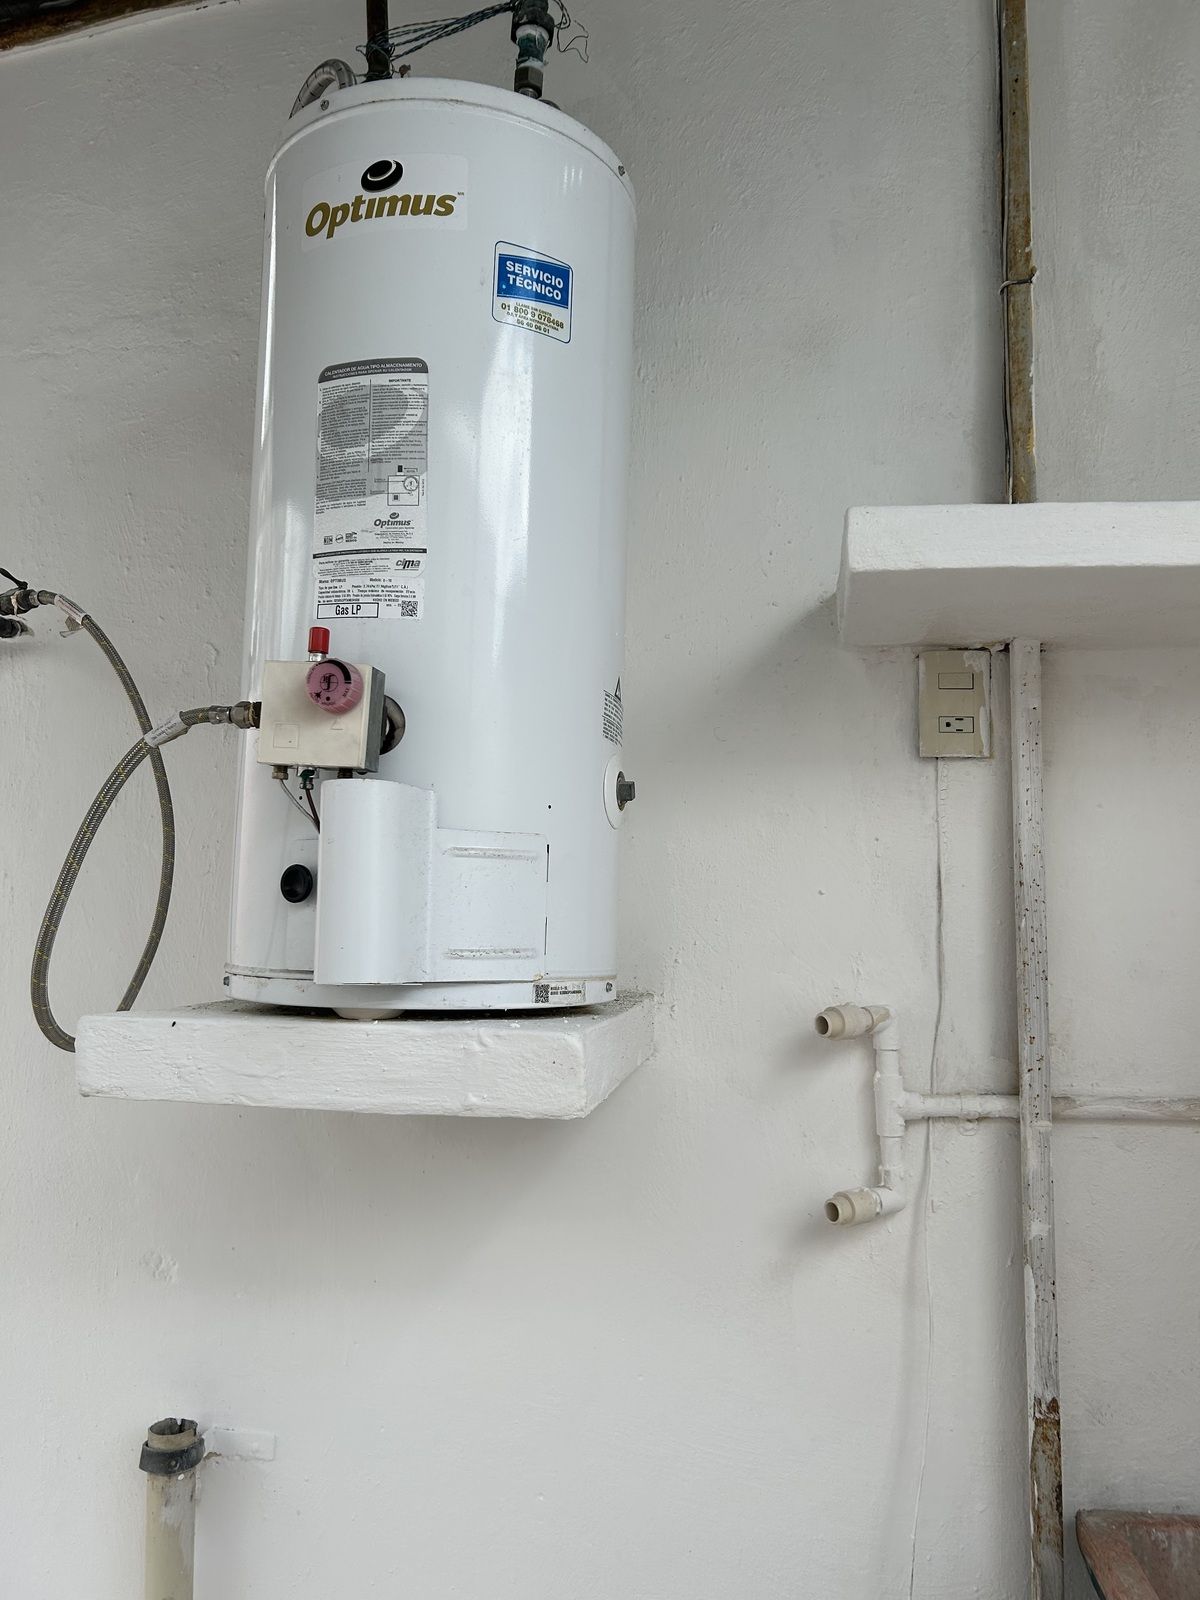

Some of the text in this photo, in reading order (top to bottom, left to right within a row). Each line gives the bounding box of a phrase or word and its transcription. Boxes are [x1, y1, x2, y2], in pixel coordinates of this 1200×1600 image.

[304, 193, 457, 240] Optimus
[505, 260, 564, 289] SERVICIO
[507, 274, 562, 301] TÉCNICO
[501, 302, 511, 311] 01
[513, 305, 529, 316] 800
[530, 310, 536, 318] 9
[324, 367, 351, 377] CALENTADOR
[373, 518, 412, 528] Optimus
[395, 558, 421, 569] cima
[335, 604, 362, 616] Gas LP
